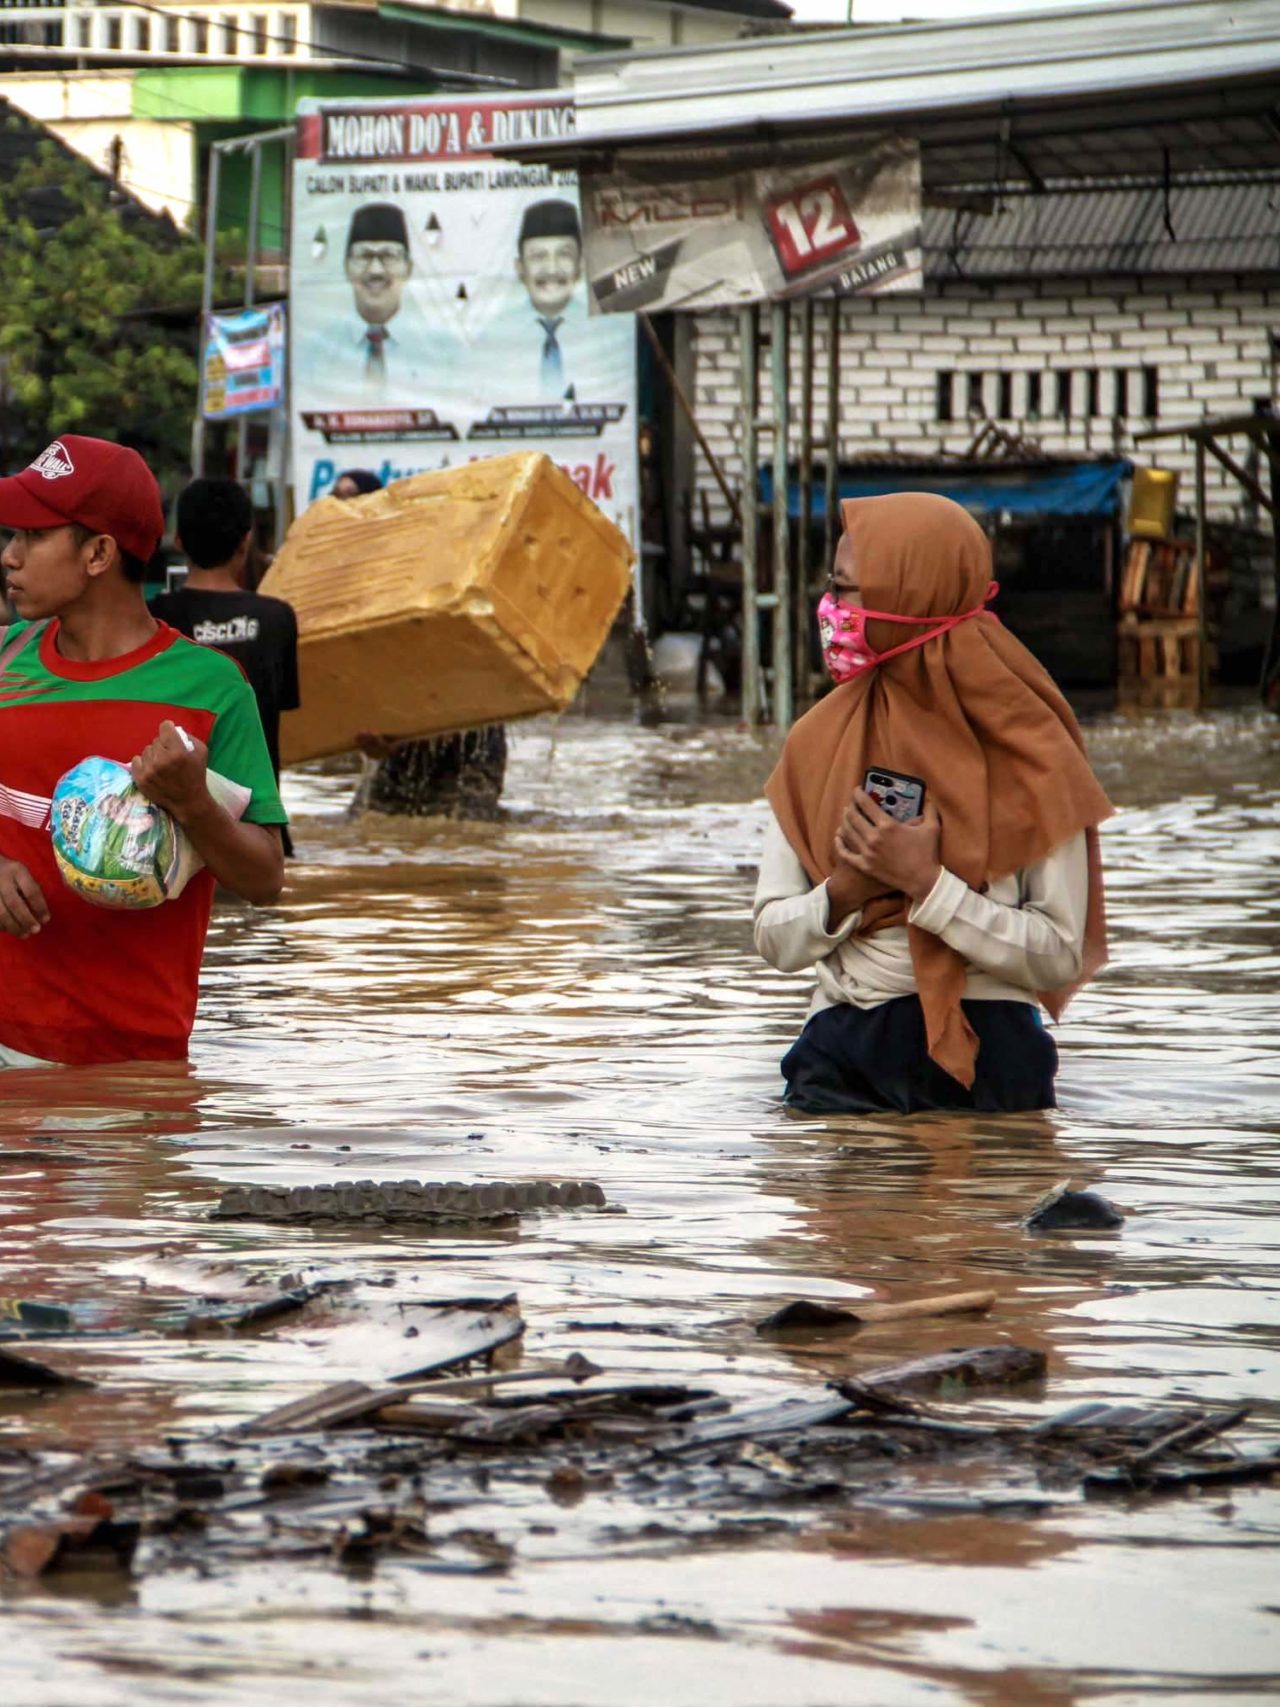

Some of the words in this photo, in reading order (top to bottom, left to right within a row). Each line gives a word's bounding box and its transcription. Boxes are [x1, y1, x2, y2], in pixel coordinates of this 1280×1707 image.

[327, 113, 405, 157] MOHON
[409, 112, 461, 155] DO'A
[467, 110, 487, 145] &
[306, 174, 345, 194] CALON
[349, 173, 388, 194] BUPATI
[392, 173, 400, 193] &
[404, 172, 440, 192] WAKIL
[445, 170, 486, 190] BUPATI
[488, 167, 554, 188] LAMONGAN
[775, 190, 848, 256] 12
[614, 258, 657, 290] NEW
[840, 252, 897, 290] BATANG
